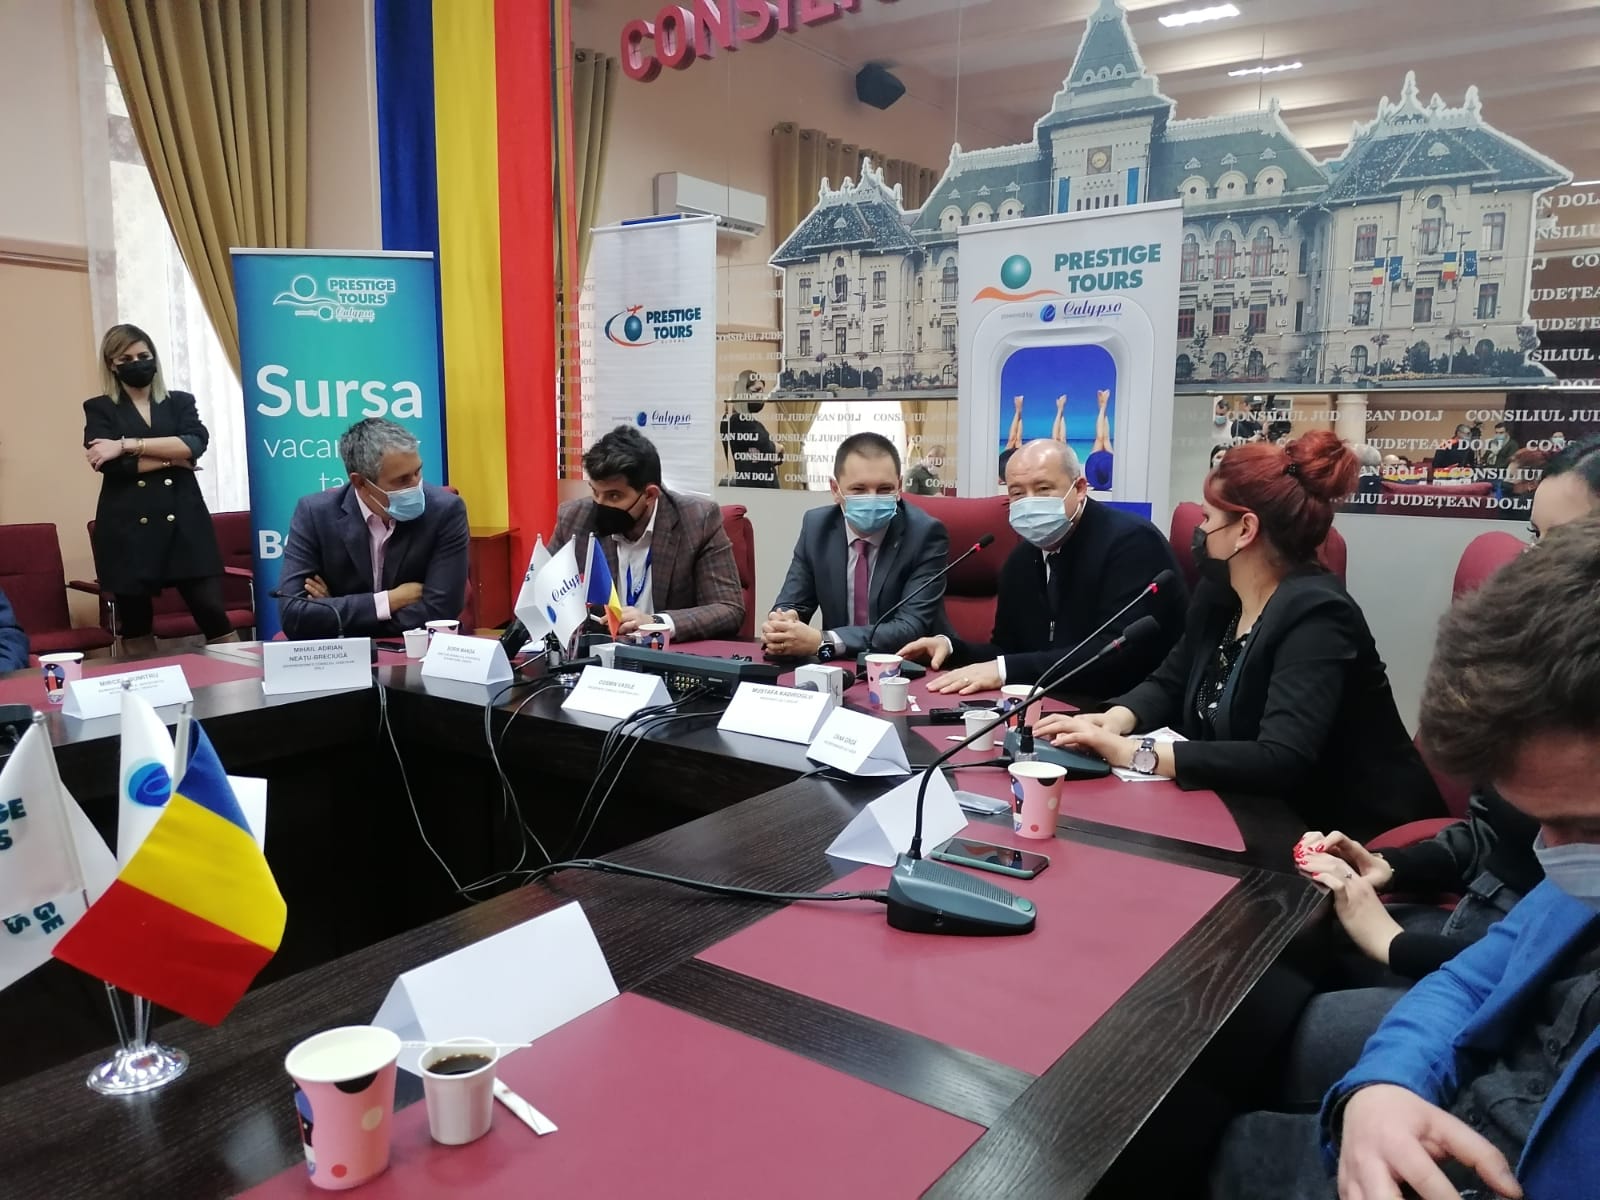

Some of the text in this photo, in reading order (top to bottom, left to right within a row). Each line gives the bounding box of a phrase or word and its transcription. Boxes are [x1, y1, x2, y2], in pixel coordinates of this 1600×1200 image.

[1558, 193, 1600, 208] DOL
[1054, 243, 1161, 272] PRESTIGE
[329, 279, 394, 291] PRESTIGE
[1068, 269, 1143, 294] TOURS
[339, 293, 386, 305] TOURS
[646, 307, 702, 324] PRESTIGE
[1063, 300, 1122, 319] Calypso
[653, 325, 693, 340] TOURS
[716, 331, 759, 341] COSILIUL
[256, 364, 423, 419] Sursa
[650, 410, 692, 426] Calypso
[837, 413, 862, 421] DOLJ
[1226, 410, 1307, 422] CONSILIUL
[1310, 409, 1398, 424] JUDEAN
[1400, 410, 1444, 422] DOLJ
[1465, 410, 1565, 422] CONSILIUL
[737, 433, 759, 441] DOLJ
[1367, 438, 1453, 452] JUDEȚEAN
[734, 452, 781, 461] CONSILIUL
[752, 472, 775, 482] DOLJ
[1391, 495, 1481, 509] JUDEȚEAN
[1487, 497, 1532, 511] DOLJ
[318, 644, 344, 652] ADRIAN
[751, 687, 778, 696] MUSTAFA
